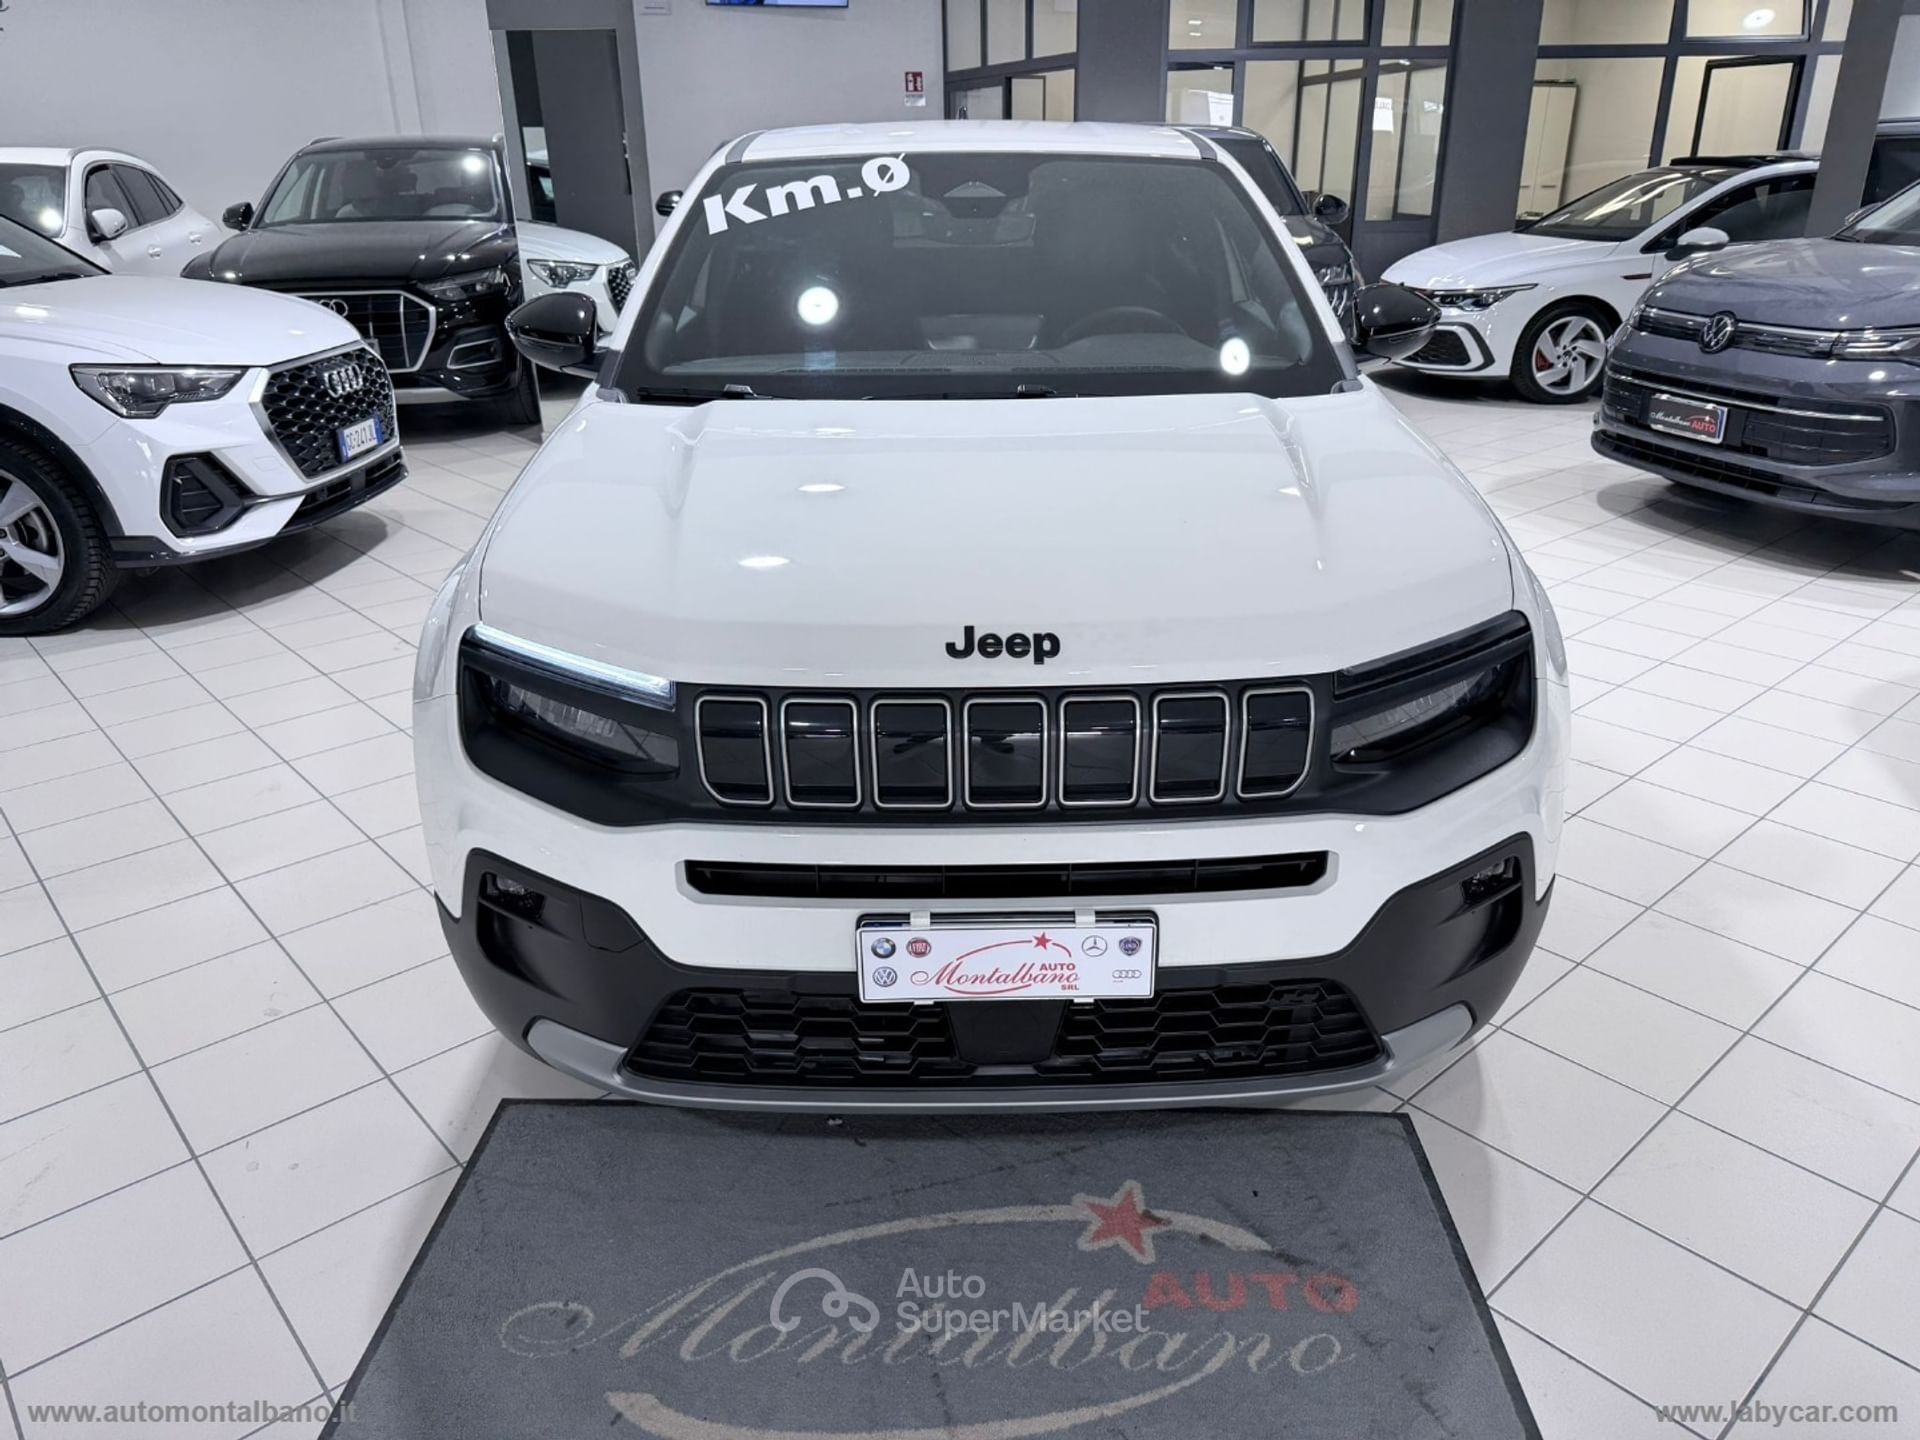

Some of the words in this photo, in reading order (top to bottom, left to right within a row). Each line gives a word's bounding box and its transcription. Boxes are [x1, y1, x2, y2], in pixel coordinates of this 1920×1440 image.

[1691, 420, 1716, 433] AUTO
[945, 625, 1061, 665] Jeep
[910, 960, 1081, 986] Montalbano
[1039, 962, 1077, 972] AUTO
[1142, 1271, 1361, 1314] AUTO
[500, 1271, 1357, 1376] Montalbano
